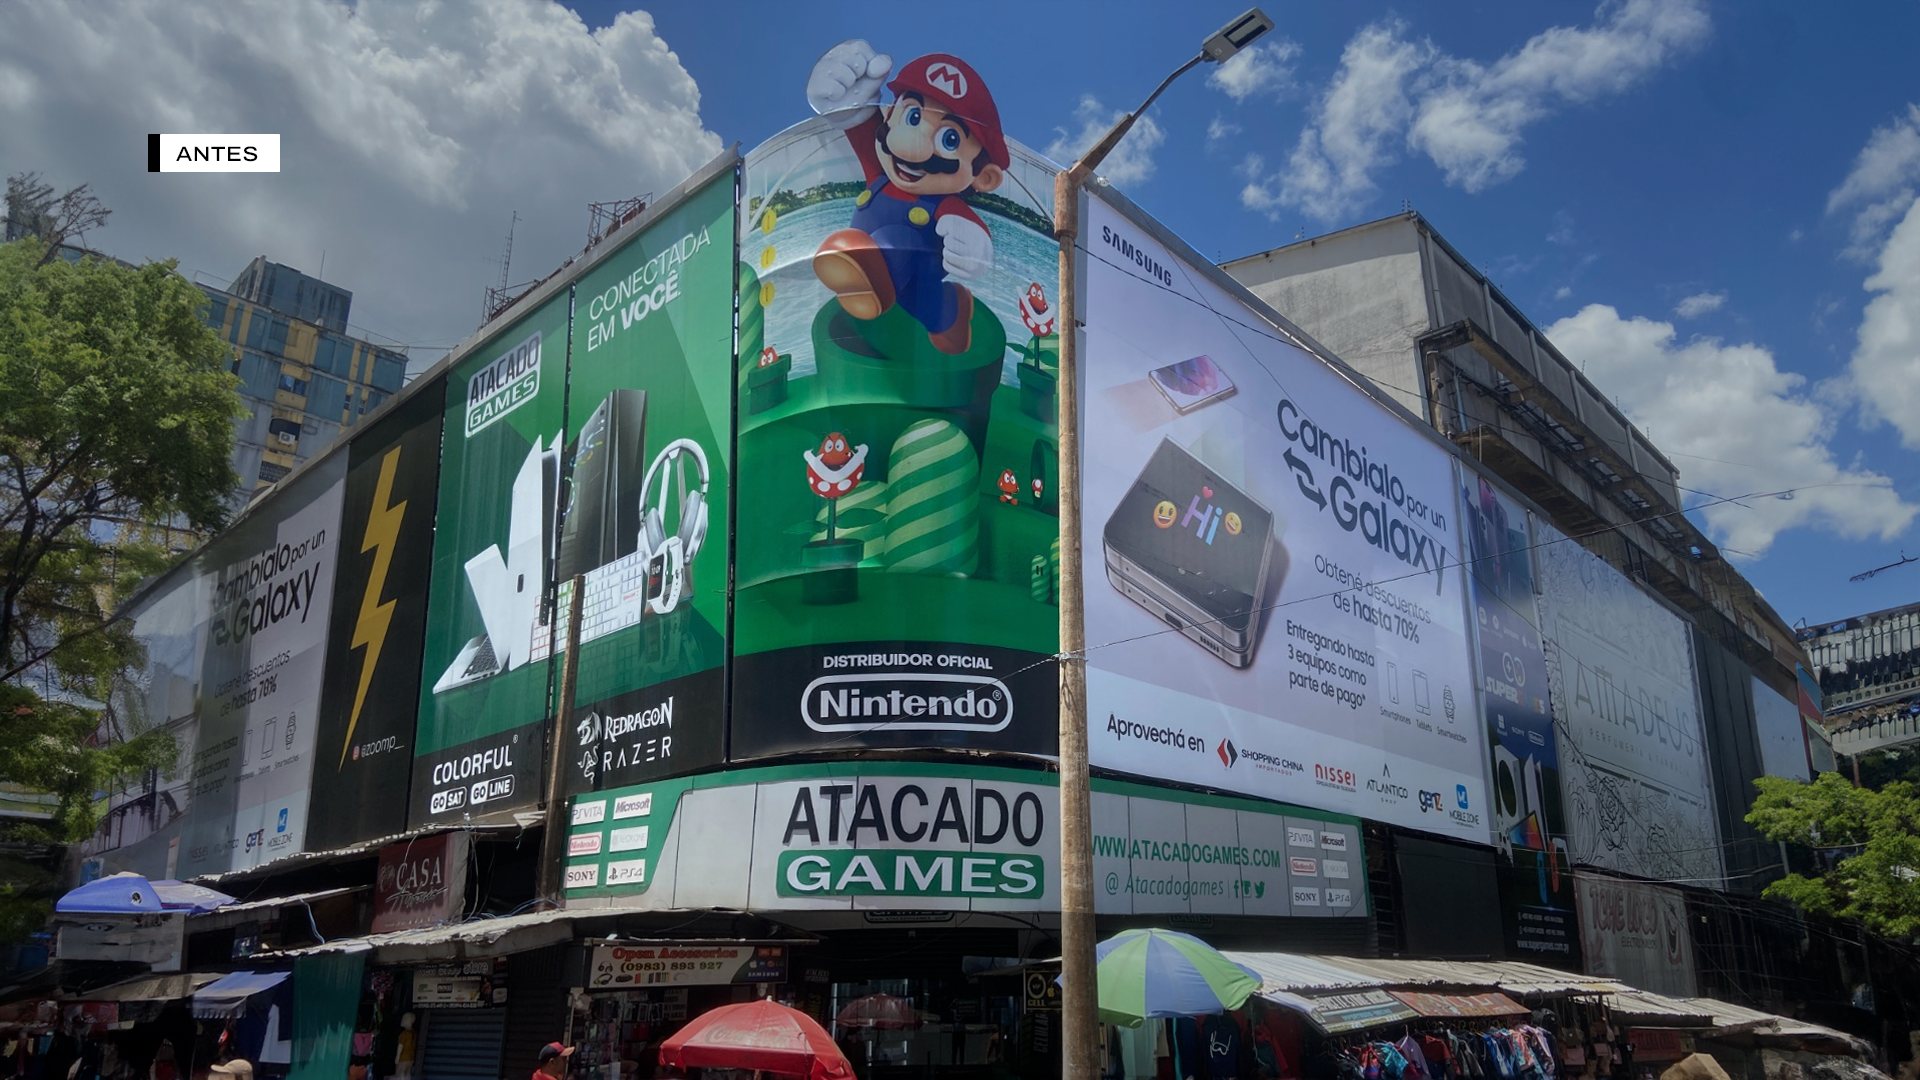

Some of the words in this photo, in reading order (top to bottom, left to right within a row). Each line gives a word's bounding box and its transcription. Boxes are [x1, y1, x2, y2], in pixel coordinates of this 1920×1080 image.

[589, 224, 711, 320] CONECTADA
[1102, 224, 1173, 288] SAMSUNG
[587, 324, 615, 352] EM
[469, 336, 540, 409] ATACADO
[469, 373, 536, 429] GAMES
[1276, 398, 1405, 507] Cambialo
[1406, 494, 1429, 521] por
[1431, 508, 1447, 532] un
[1180, 494, 1224, 546] Hi
[1329, 479, 1447, 597] Galaxy
[291, 541, 310, 566] por
[311, 527, 326, 552] un
[232, 561, 321, 645] Galaxy
[1314, 554, 1363, 592] Obtené
[1362, 572, 1432, 625] descuentos
[1332, 592, 1352, 613] de
[1352, 598, 1393, 633] hasta
[1393, 610, 1420, 645] 70%
[822, 653, 933, 669] DISTRIBUIDOR
[936, 654, 993, 670] OFICIAL
[1286, 618, 1346, 659] Entregando
[1347, 641, 1375, 668] hasta
[1287, 643, 1295, 660] 3
[1295, 649, 1337, 680] equipos
[1338, 665, 1367, 686] como
[1289, 669, 1319, 697] parte
[1320, 676, 1335, 698] de
[603, 696, 674, 743] REDRAGON
[1106, 713, 1186, 749] Aprovechá
[1187, 735, 1206, 754] en
[432, 744, 513, 786] COLORFUL
[1241, 748, 1281, 767] SHOPPING
[1281, 758, 1305, 773] CHINA
[432, 797, 446, 811] GO
[447, 790, 465, 808] SAT
[473, 786, 487, 802] GO
[488, 778, 511, 798] LINE
[615, 797, 650, 814] Microsoft
[782, 784, 1044, 847] ATACADO
[1321, 835, 1345, 847] Microsoft
[396, 856, 443, 890] CASA
[567, 870, 596, 882] SONY
[620, 867, 643, 878] PS4
[786, 855, 1038, 894] GAMES
[1125, 873, 1224, 900] Atacadogames
[1294, 892, 1317, 902] SONY
[1334, 894, 1351, 902] PS4
[612, 948, 656, 961] Open
[620, 961, 656, 973] (0983)
[670, 961, 695, 970] 893
[699, 961, 723, 970] 927
